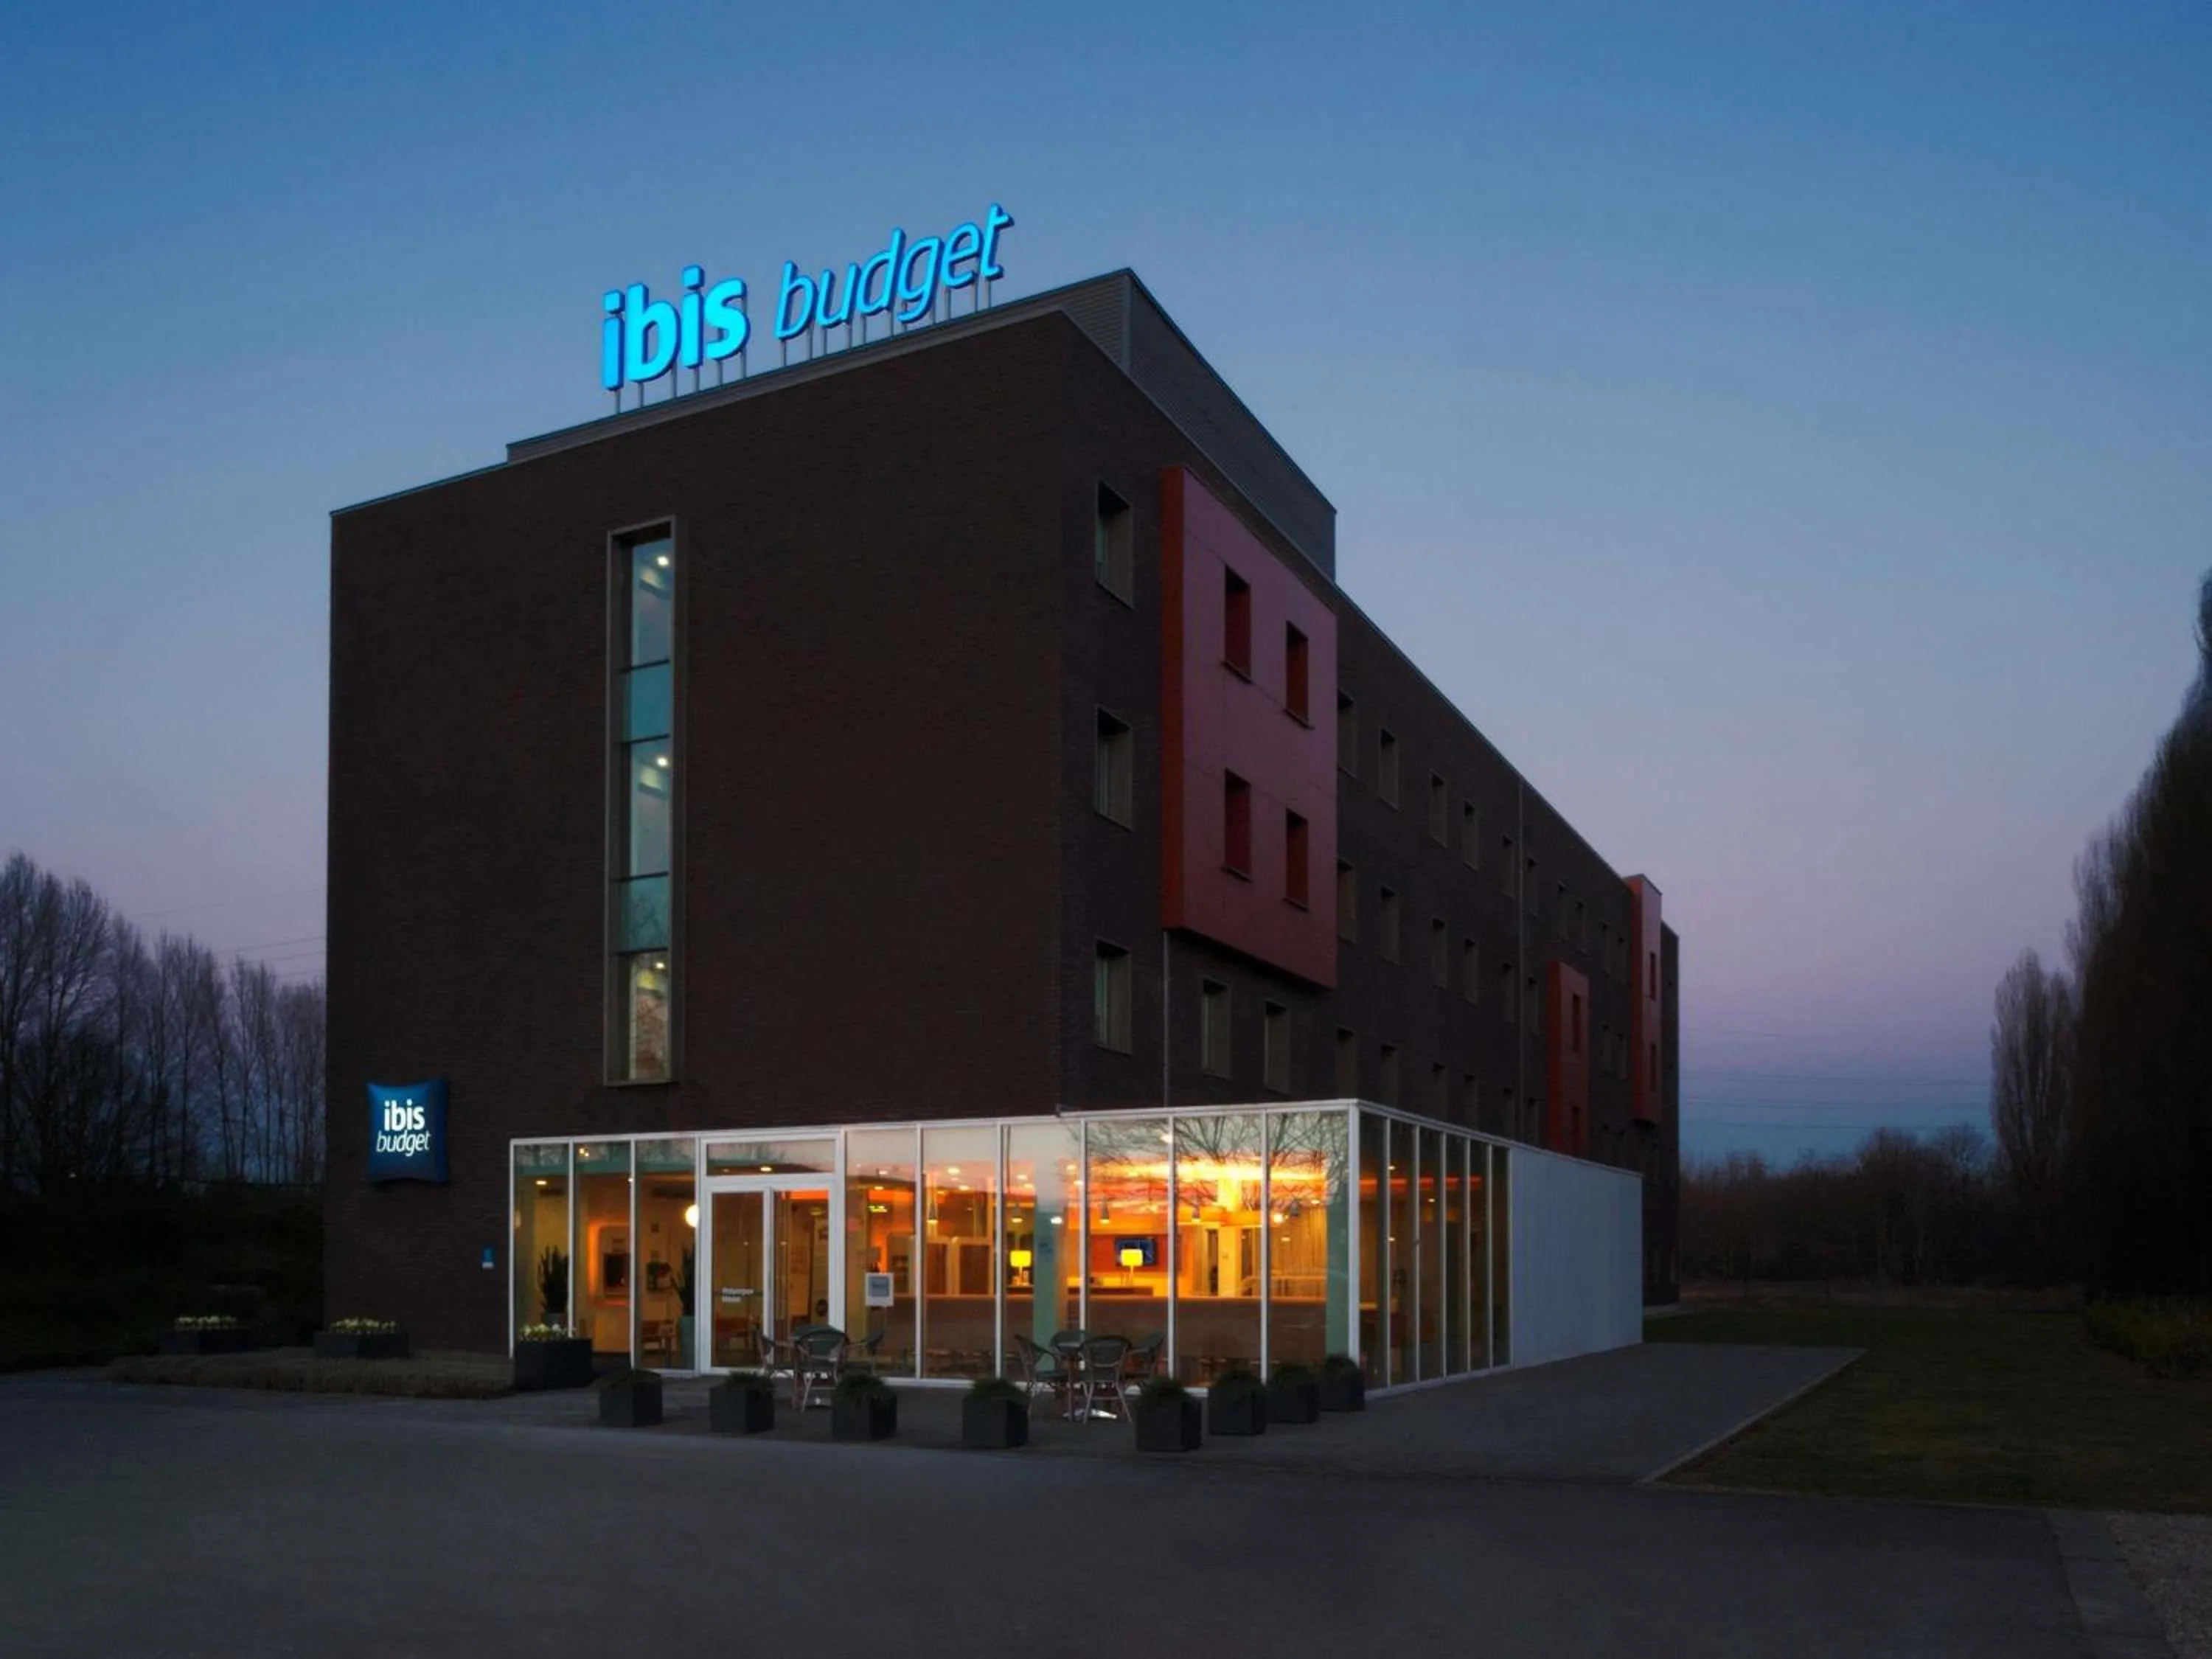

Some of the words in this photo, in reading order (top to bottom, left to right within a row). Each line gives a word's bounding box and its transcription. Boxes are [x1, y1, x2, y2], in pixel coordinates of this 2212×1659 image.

[602, 265, 750, 391] ibis
[774, 203, 1015, 341] budget
[383, 1099, 425, 1131] ibis
[376, 1130, 432, 1157] budget
